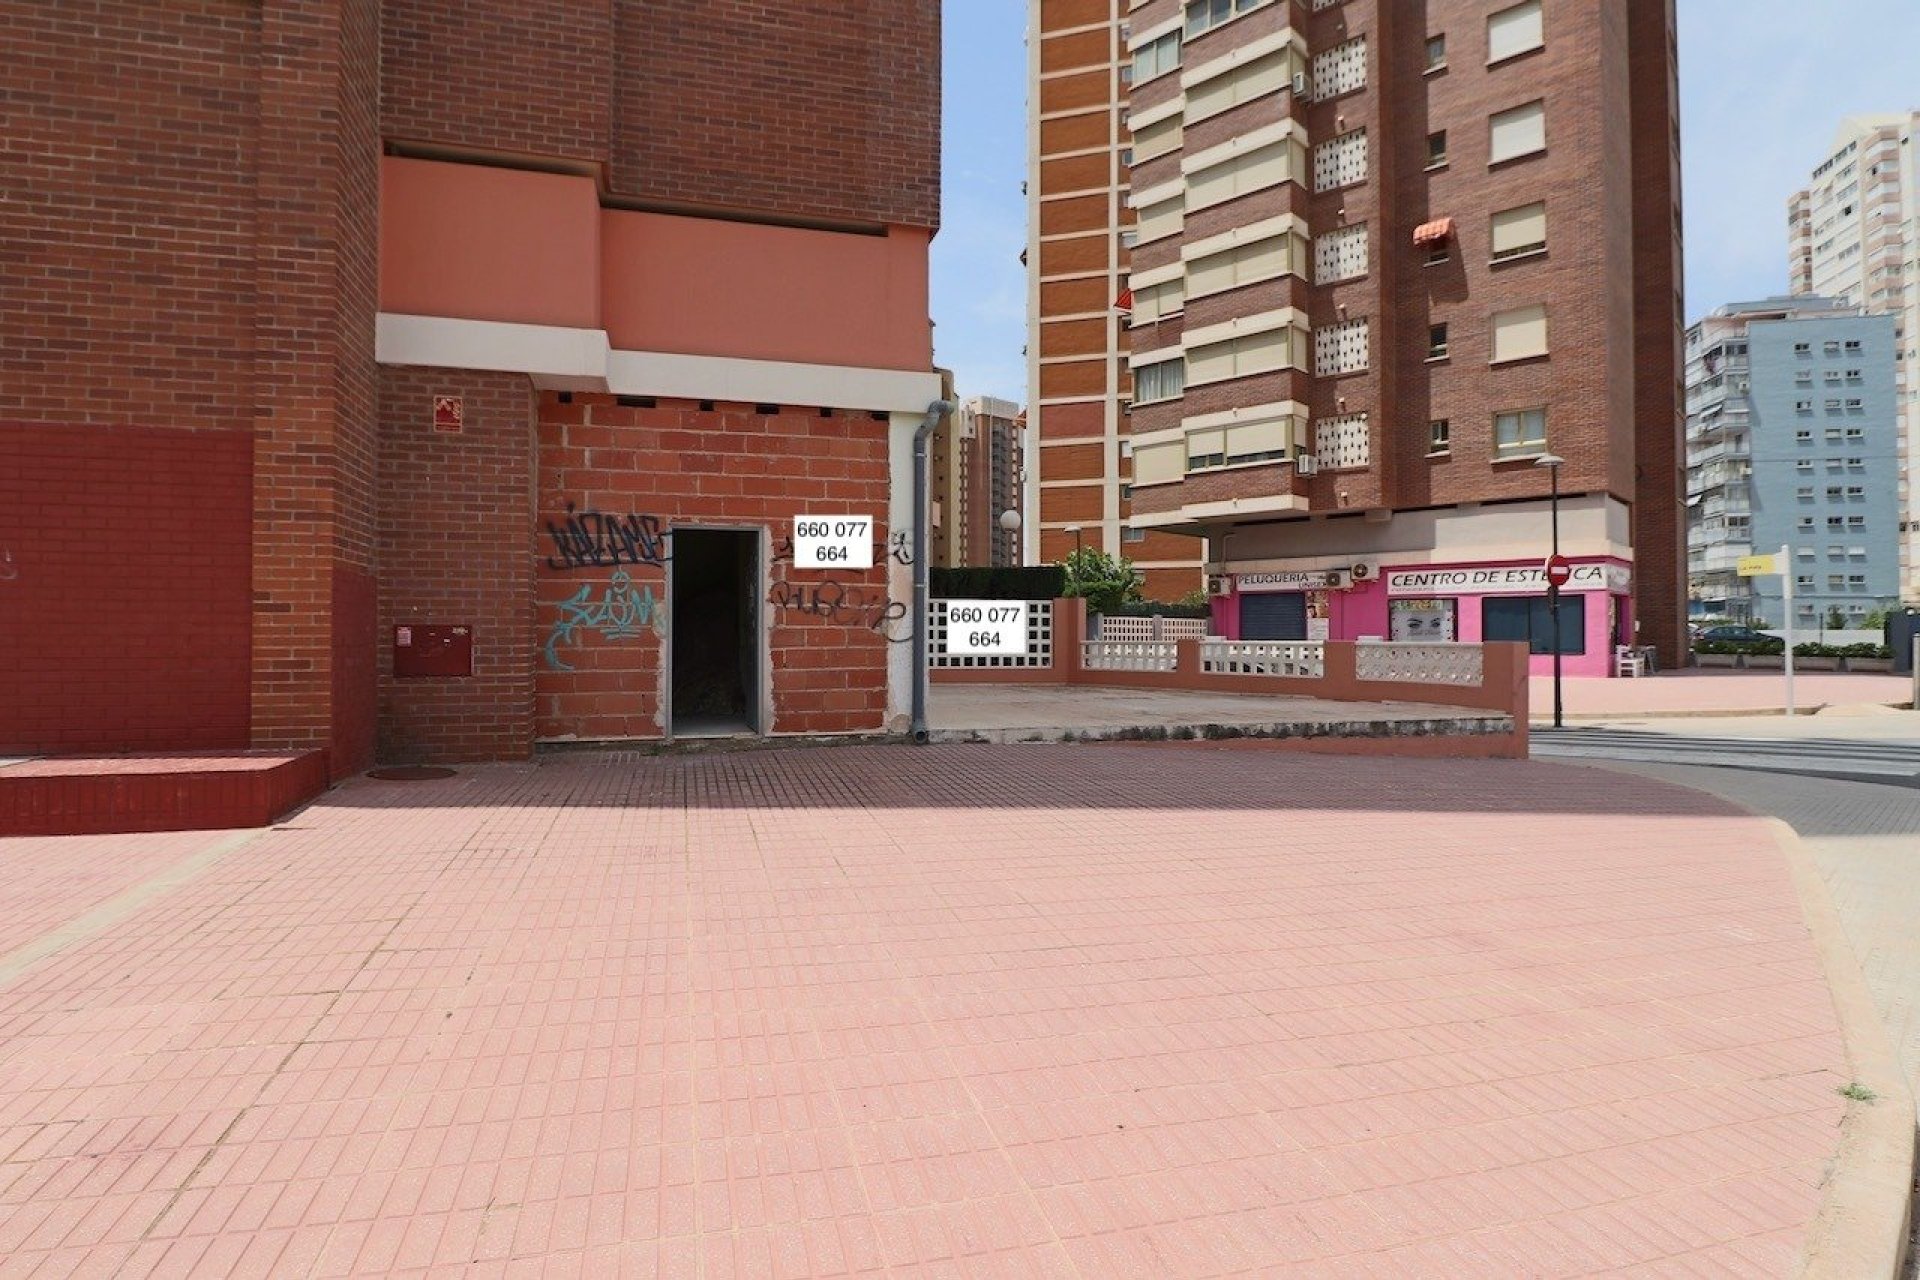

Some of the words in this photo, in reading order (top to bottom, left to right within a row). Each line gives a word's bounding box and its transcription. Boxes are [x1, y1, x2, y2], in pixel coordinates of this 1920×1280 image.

[1238, 572, 1309, 585] PELUQUERIA
[1391, 572, 1467, 587] CENTRO
[1473, 570, 1500, 583] DE
[1505, 566, 1603, 583] ESTCA
